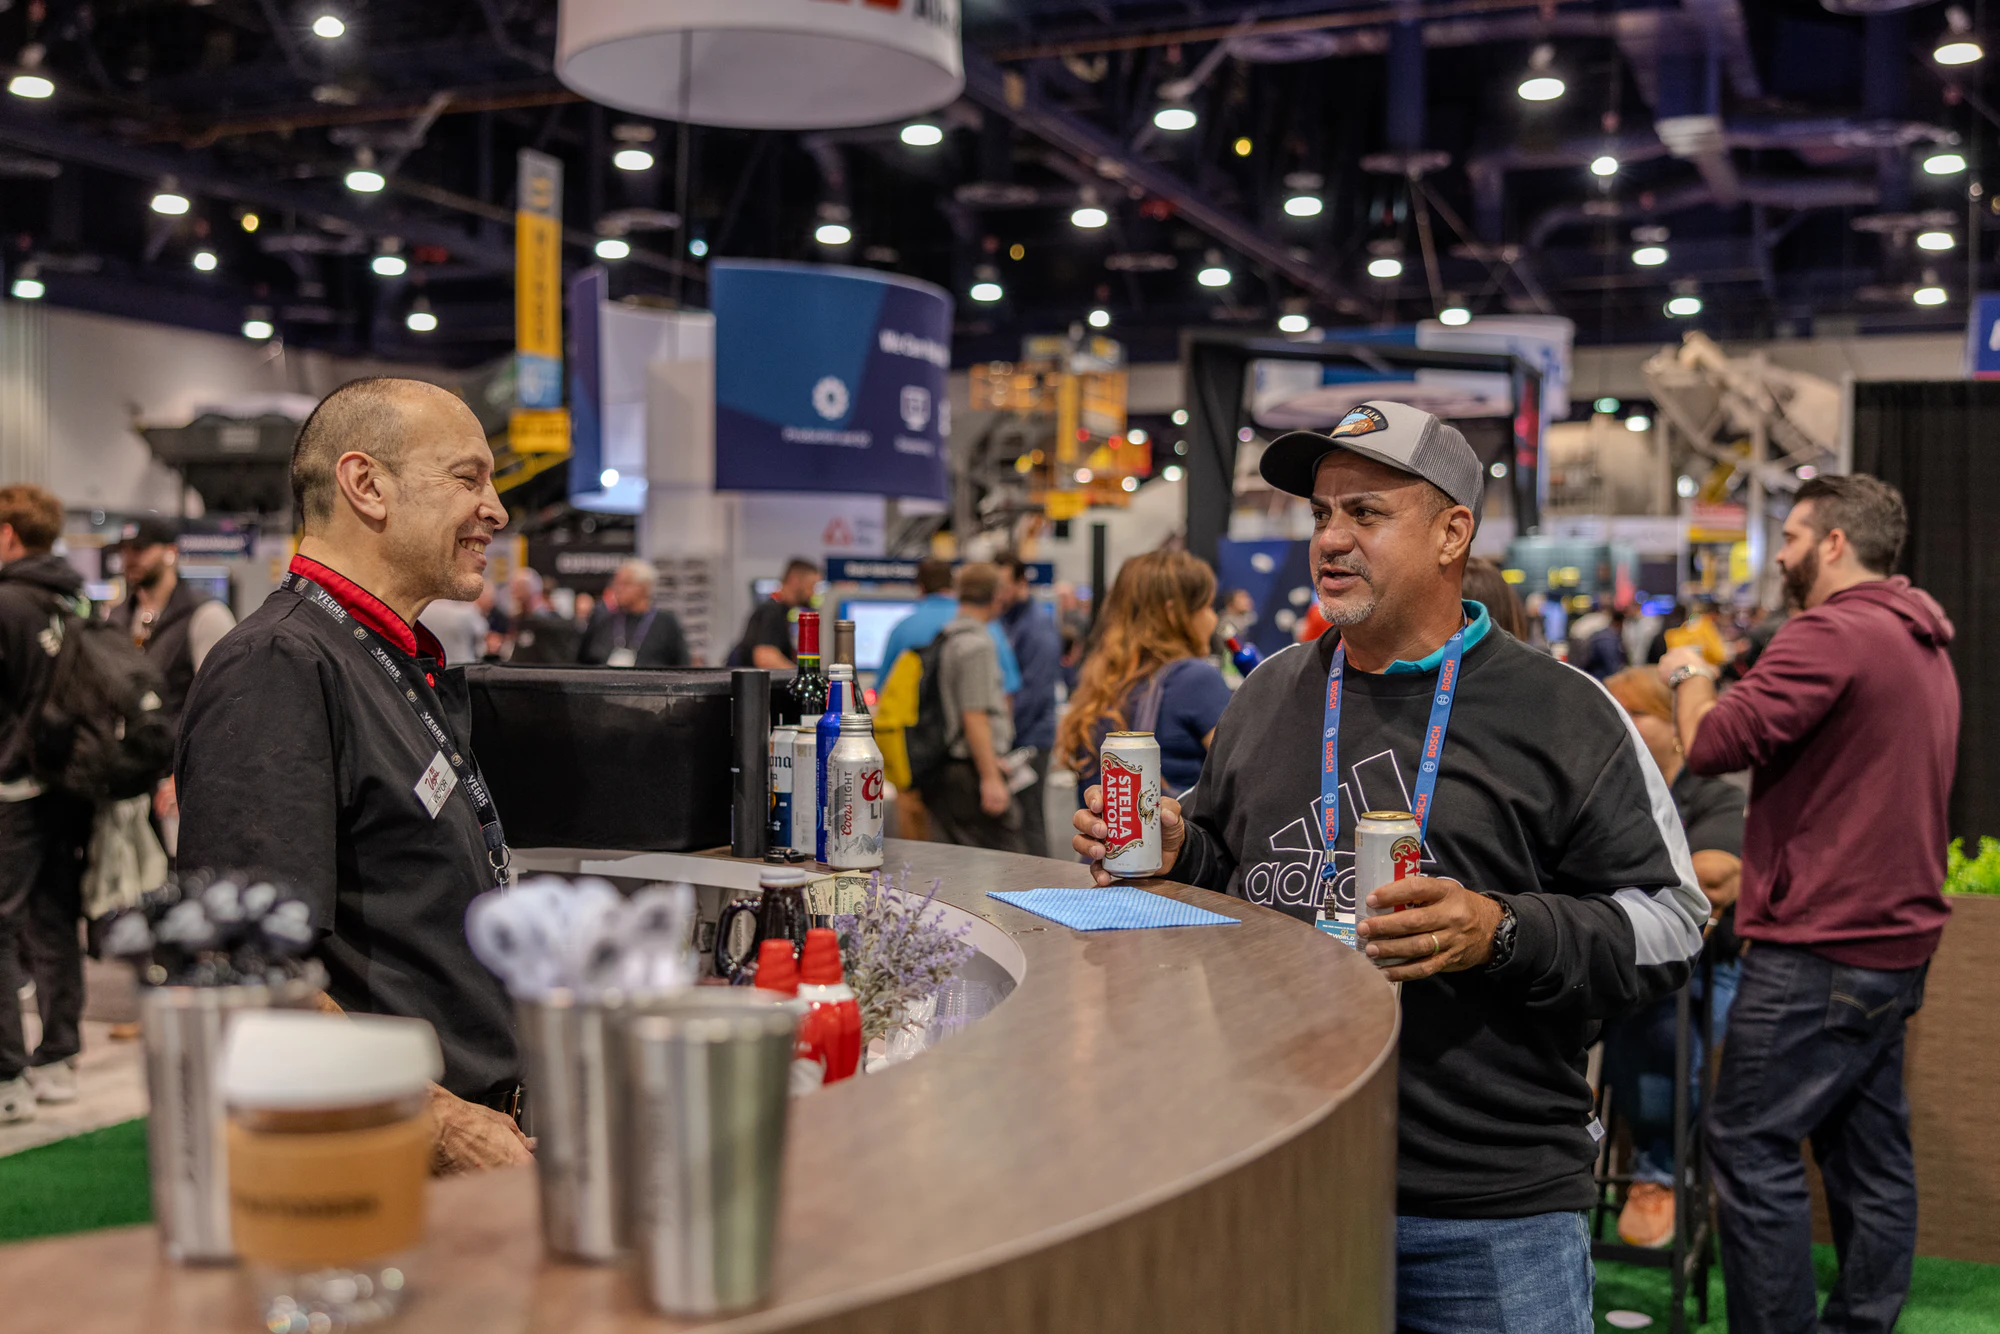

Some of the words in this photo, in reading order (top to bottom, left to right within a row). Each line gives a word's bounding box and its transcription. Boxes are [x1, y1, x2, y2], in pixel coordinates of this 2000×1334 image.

[1363, 408, 1381, 422] DAM
[317, 590, 348, 619] VEGAS
[376, 647, 402, 678] VEGAS
[1440, 659, 1456, 691] BOSCH
[1329, 680, 1339, 710] BOSCH
[424, 711, 447, 744] VEGAS
[1426, 725, 1442, 758] BOSCH
[1325, 740, 1334, 773] BOSCH
[432, 779, 449, 804] VICTOR
[467, 774, 489, 808] VEGAS
[844, 771, 853, 803] LIGHT
[841, 803, 853, 836] Coors
[1106, 774, 1119, 839] ARTOIS
[1118, 775, 1132, 839] STELLA
[1325, 807, 1335, 841] BOSCH
